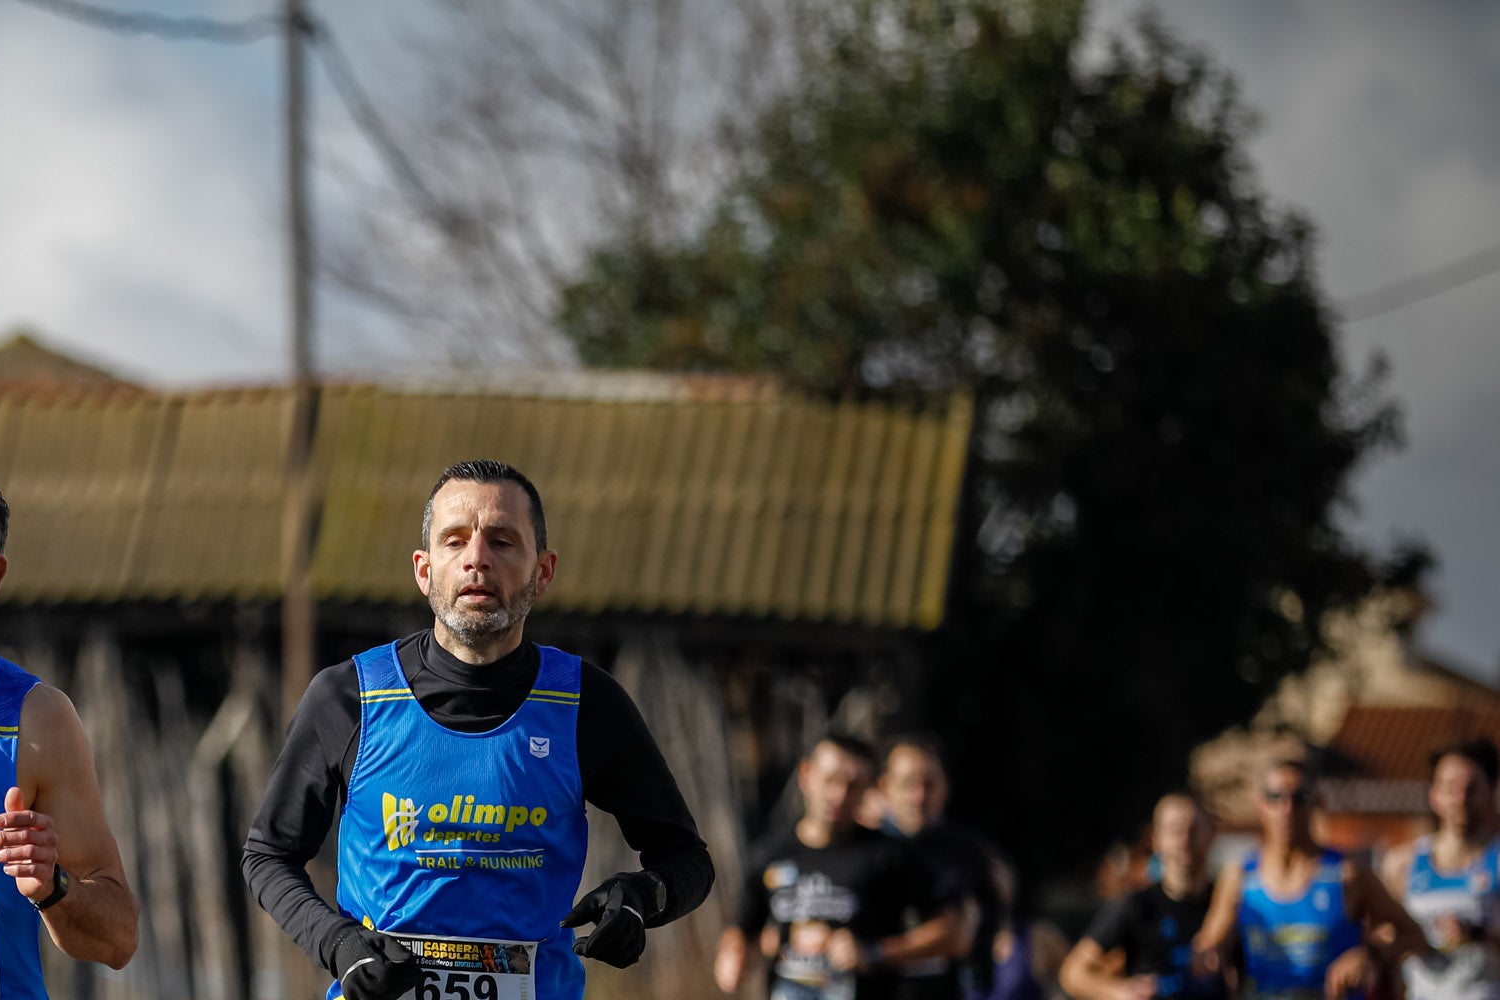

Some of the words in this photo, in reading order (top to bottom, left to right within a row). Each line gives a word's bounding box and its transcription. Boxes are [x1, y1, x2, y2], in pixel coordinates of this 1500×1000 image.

[427, 794, 548, 833] olimpo
[423, 828, 501, 845] deportes
[416, 856, 461, 869] TRAIL
[464, 856, 476, 867] &
[479, 854, 544, 870] RUNNING
[411, 941, 424, 956] VII
[423, 941, 480, 953] CARRERA
[420, 957, 454, 967] Secaderos
[423, 950, 480, 961] POPULAR
